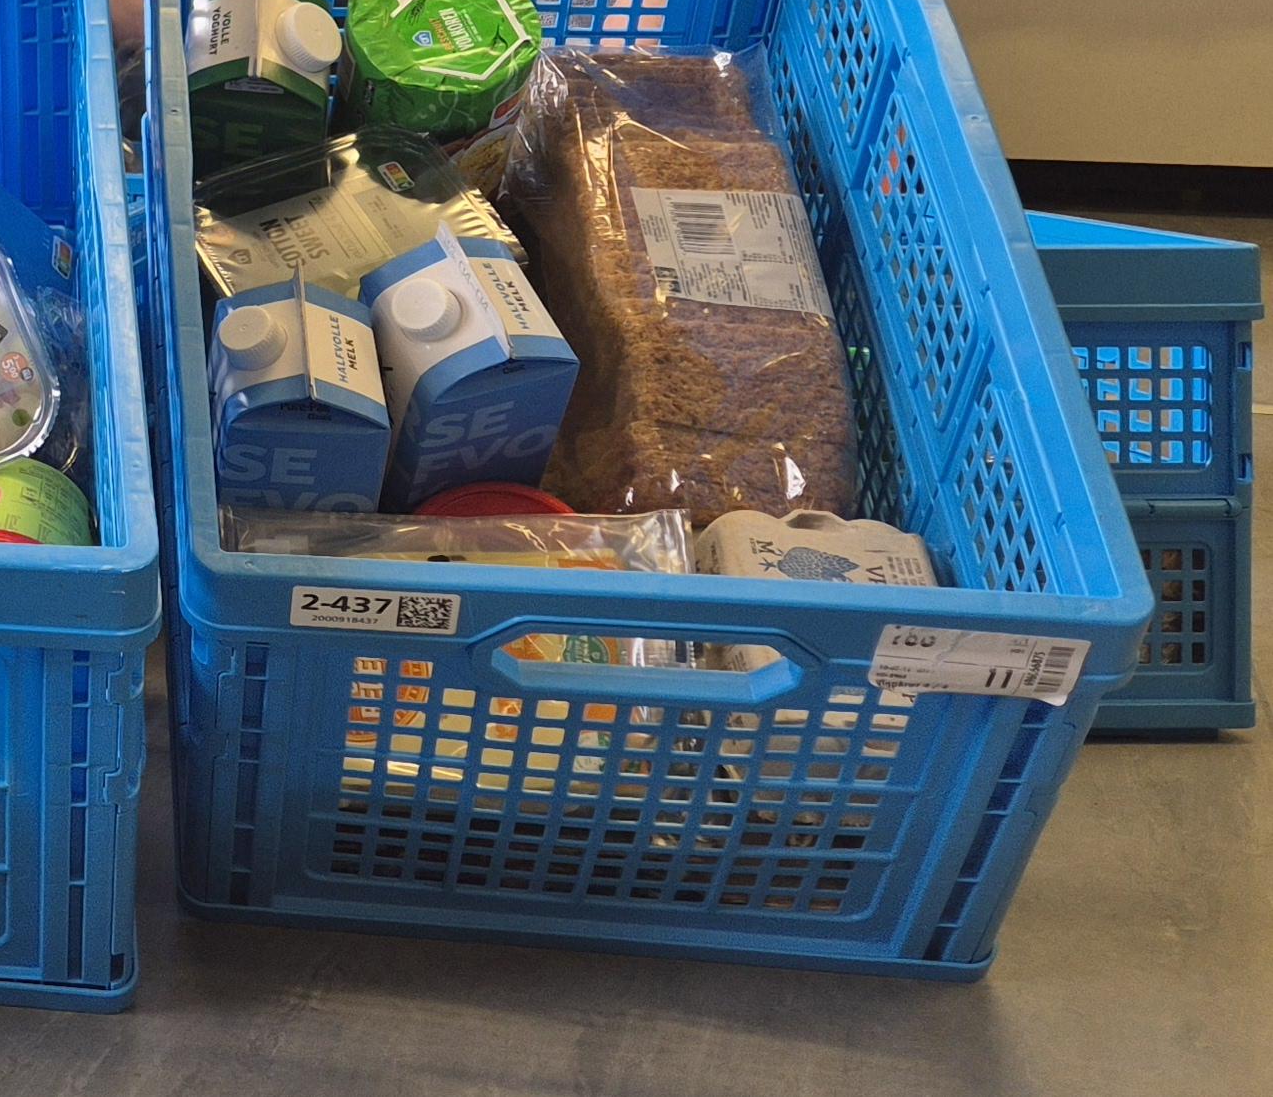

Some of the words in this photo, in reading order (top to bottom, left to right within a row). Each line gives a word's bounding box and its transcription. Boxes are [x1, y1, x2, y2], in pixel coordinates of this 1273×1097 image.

[208, 6, 221, 56] YOGHURT
[220, 10, 232, 45] VOLLE
[481, 262, 530, 330] HALFVOLLE
[506, 280, 530, 313] MELK
[329, 314, 349, 384] HALFVOLLE
[345, 338, 358, 370] MELK
[219, 444, 318, 485] SE
[300, 593, 393, 615] 2-437
[984, 668, 1014, 689] 11
